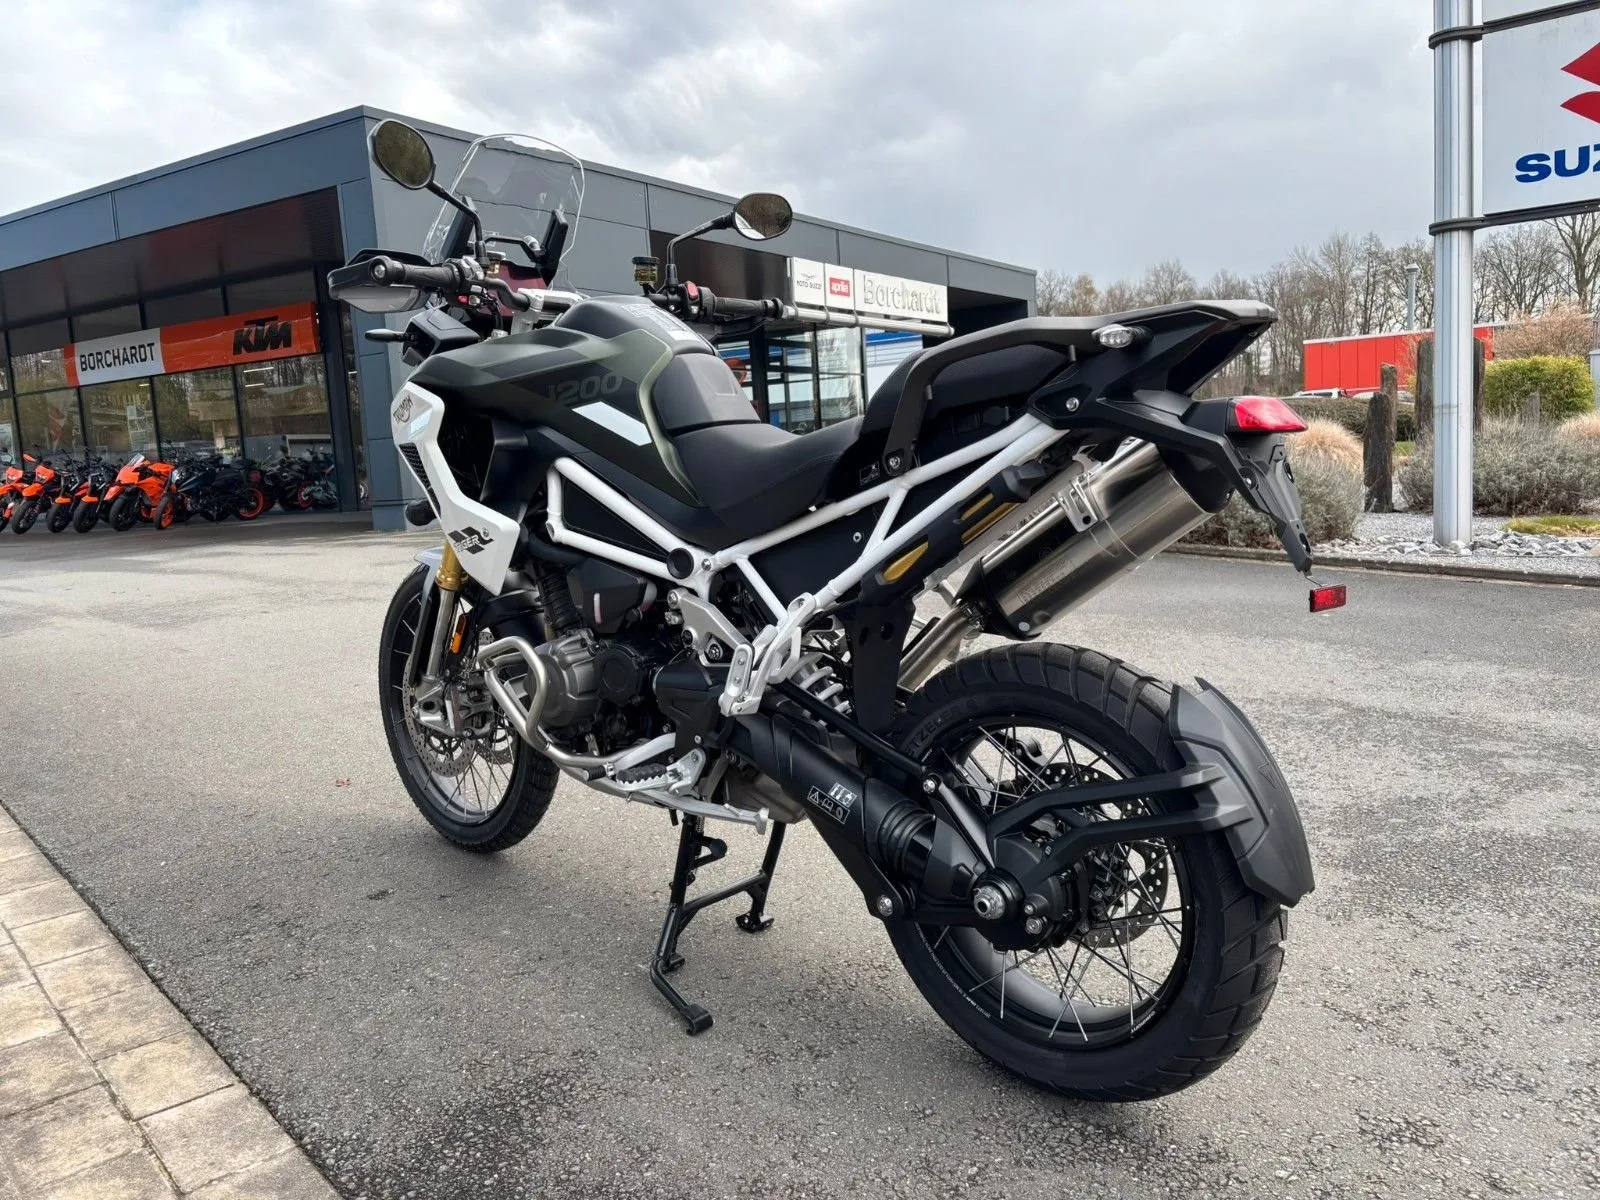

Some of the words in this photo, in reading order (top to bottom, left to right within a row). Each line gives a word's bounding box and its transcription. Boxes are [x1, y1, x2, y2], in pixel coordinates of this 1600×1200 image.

[1515, 144, 1600, 183] SU
[863, 273, 941, 315] Borchardt
[233, 315, 292, 356] KTM
[80, 342, 155, 372] BORCHARDT
[545, 372, 623, 404] 1200
